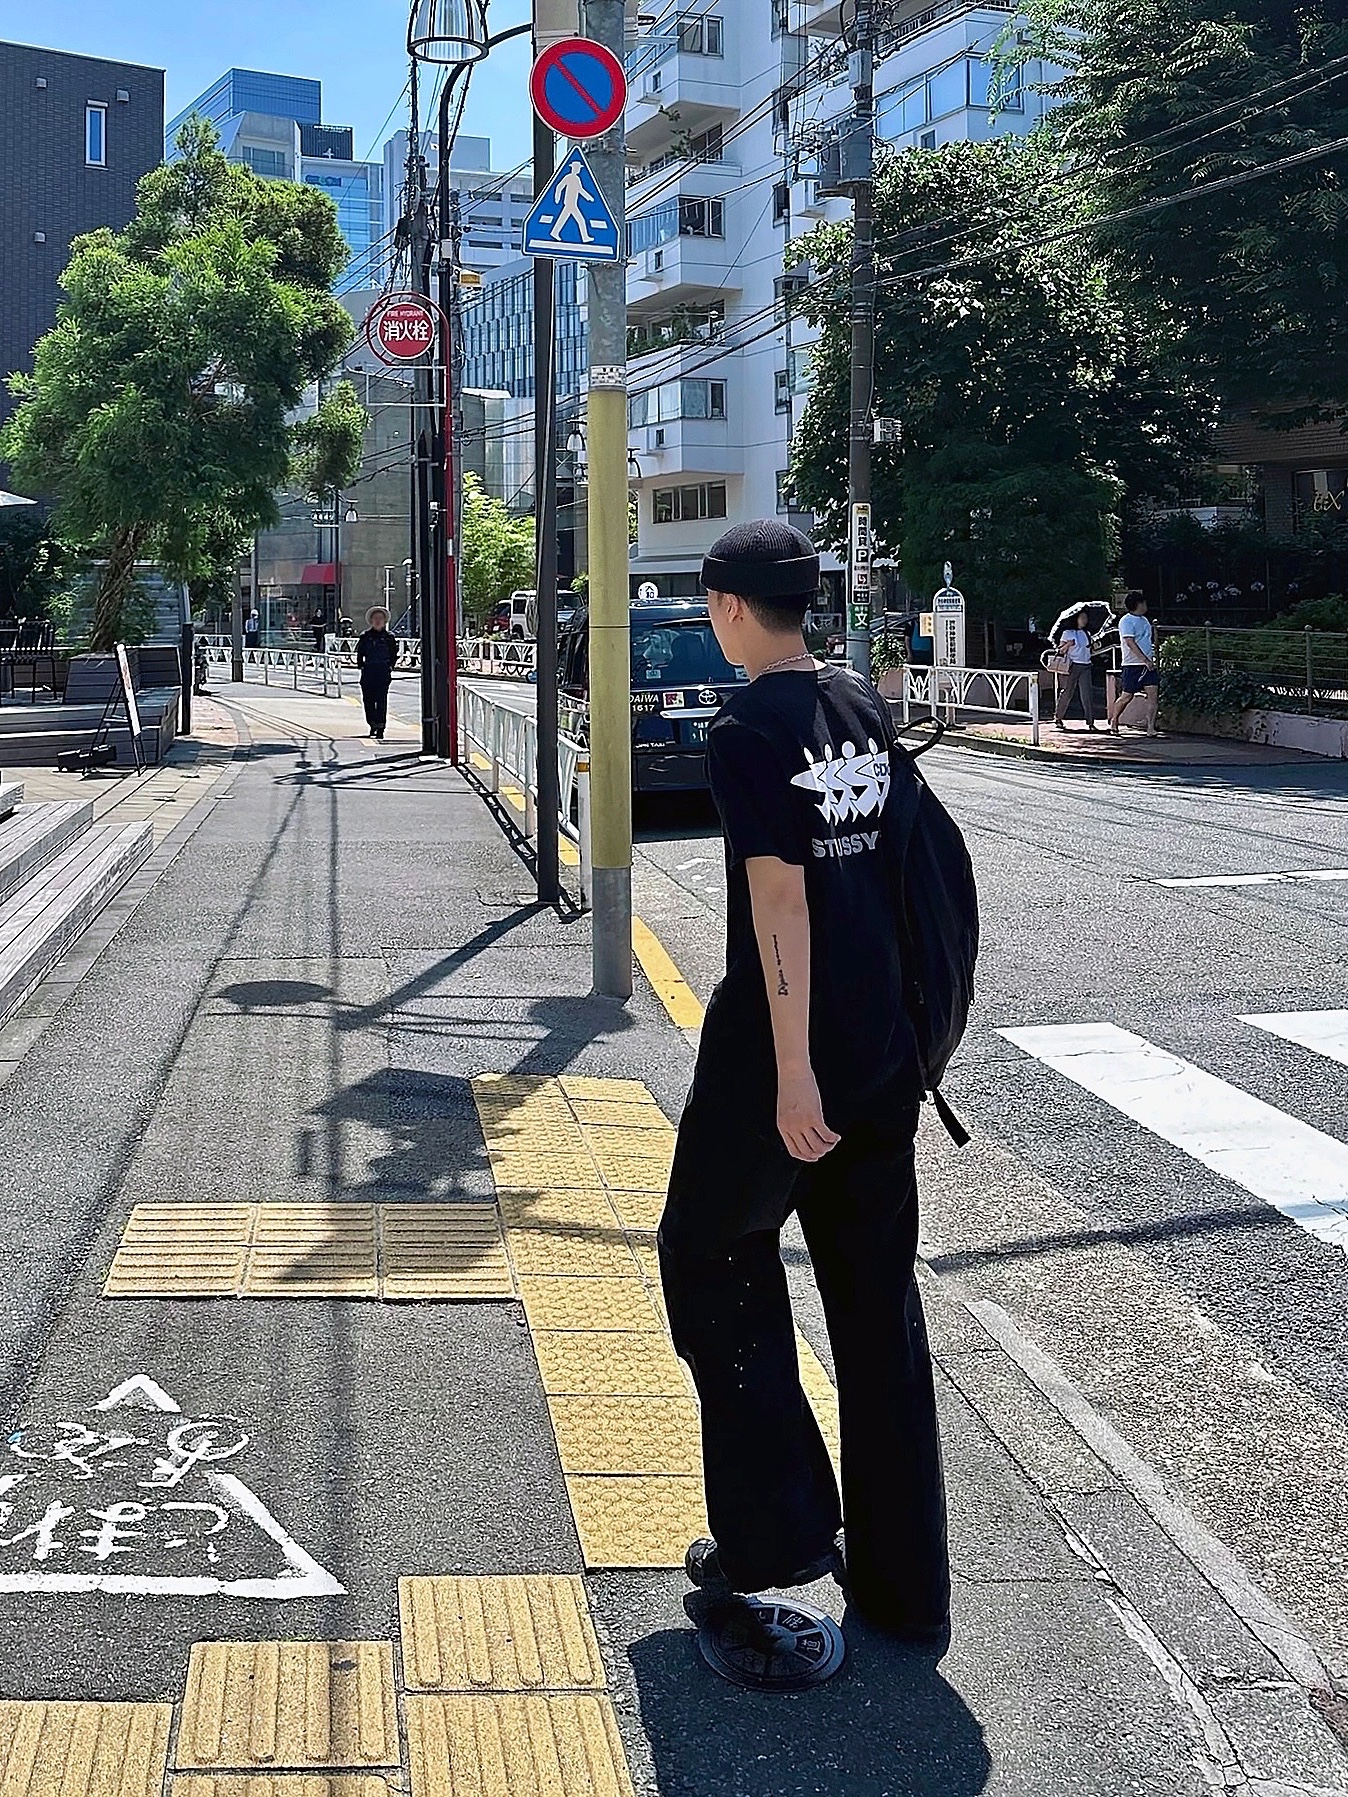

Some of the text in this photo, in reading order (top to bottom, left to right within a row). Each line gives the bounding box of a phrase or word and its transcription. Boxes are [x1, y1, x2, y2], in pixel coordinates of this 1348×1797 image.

[383, 319, 430, 341] 消火栓
[632, 704, 655, 712] 1617
